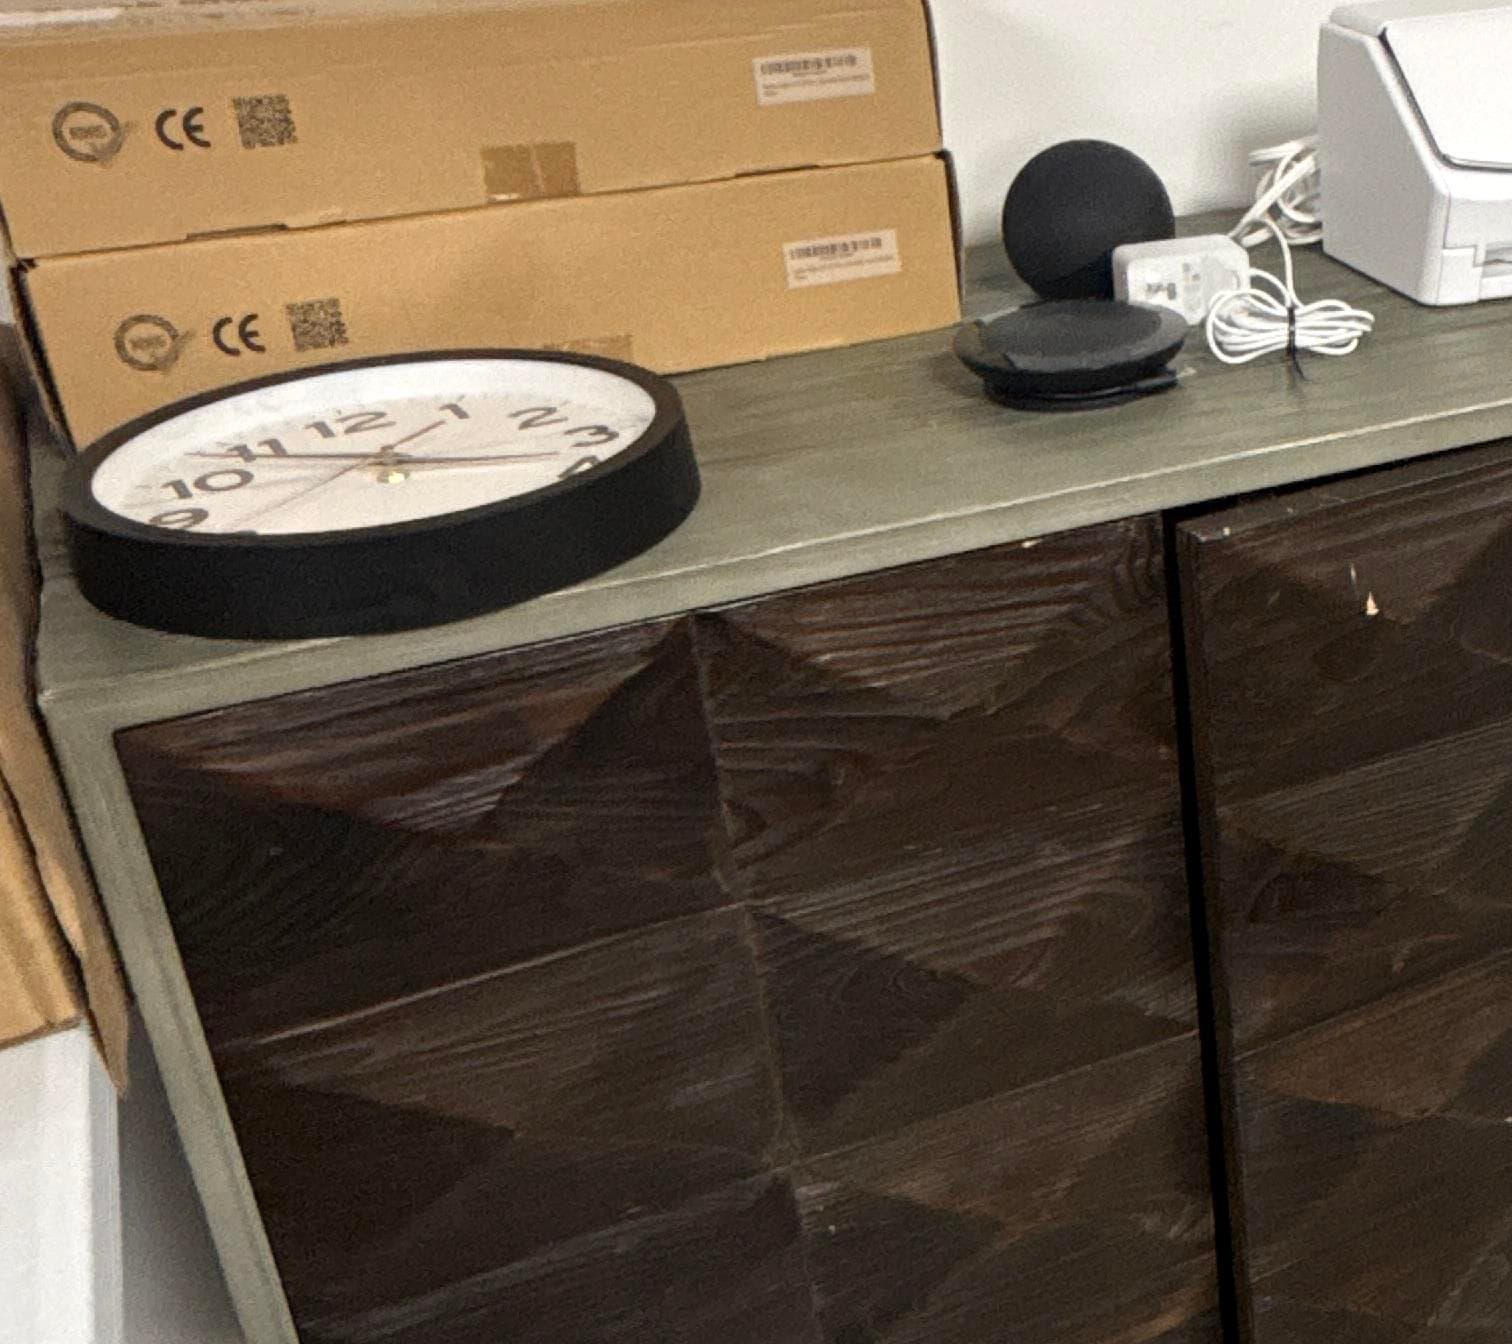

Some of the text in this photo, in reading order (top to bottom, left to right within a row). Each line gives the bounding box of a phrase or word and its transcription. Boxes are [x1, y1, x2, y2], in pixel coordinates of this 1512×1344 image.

[439, 403, 469, 420] 1
[507, 407, 569, 430] 2
[305, 411, 396, 438] 12
[564, 425, 619, 448] 3
[227, 438, 288, 462] 11
[161, 469, 254, 499] 10
[150, 508, 208, 529] 9
